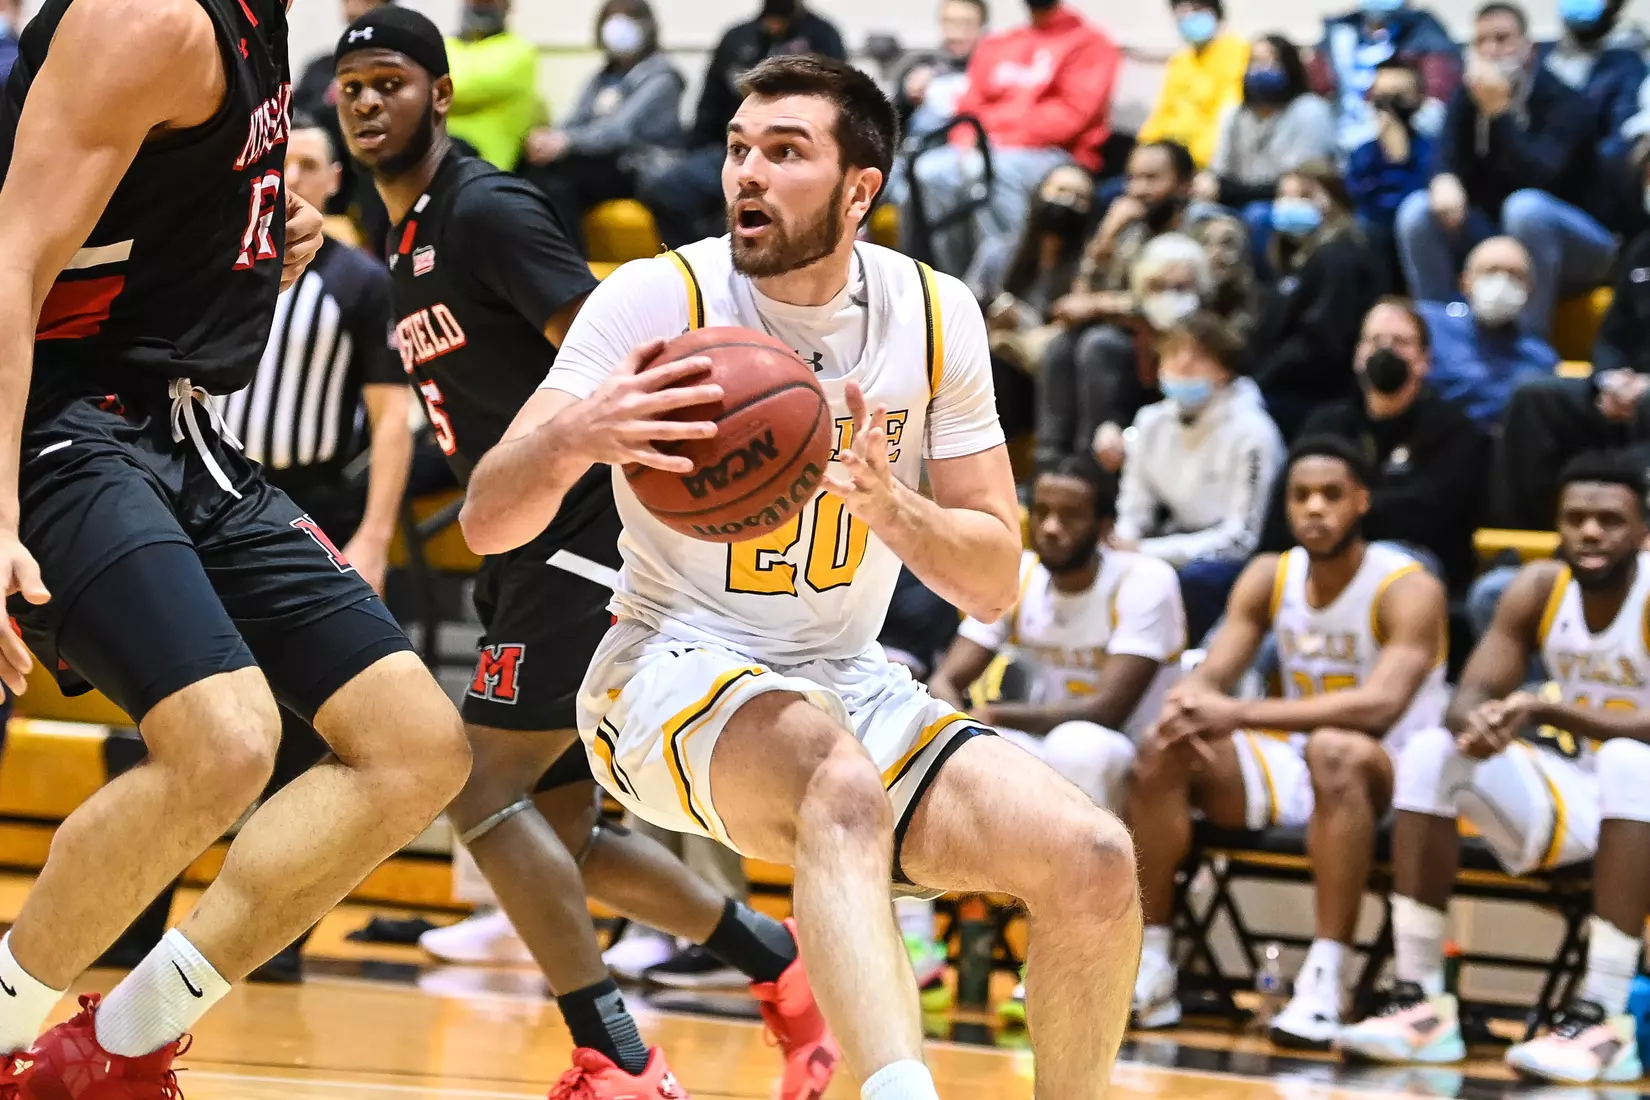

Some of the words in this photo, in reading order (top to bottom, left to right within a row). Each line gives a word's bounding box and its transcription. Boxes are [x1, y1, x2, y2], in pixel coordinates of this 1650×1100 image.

[419, 379, 456, 456] 5
[681, 429, 780, 499] NCAA
[725, 490, 870, 598] 20
[466, 643, 526, 705] M
